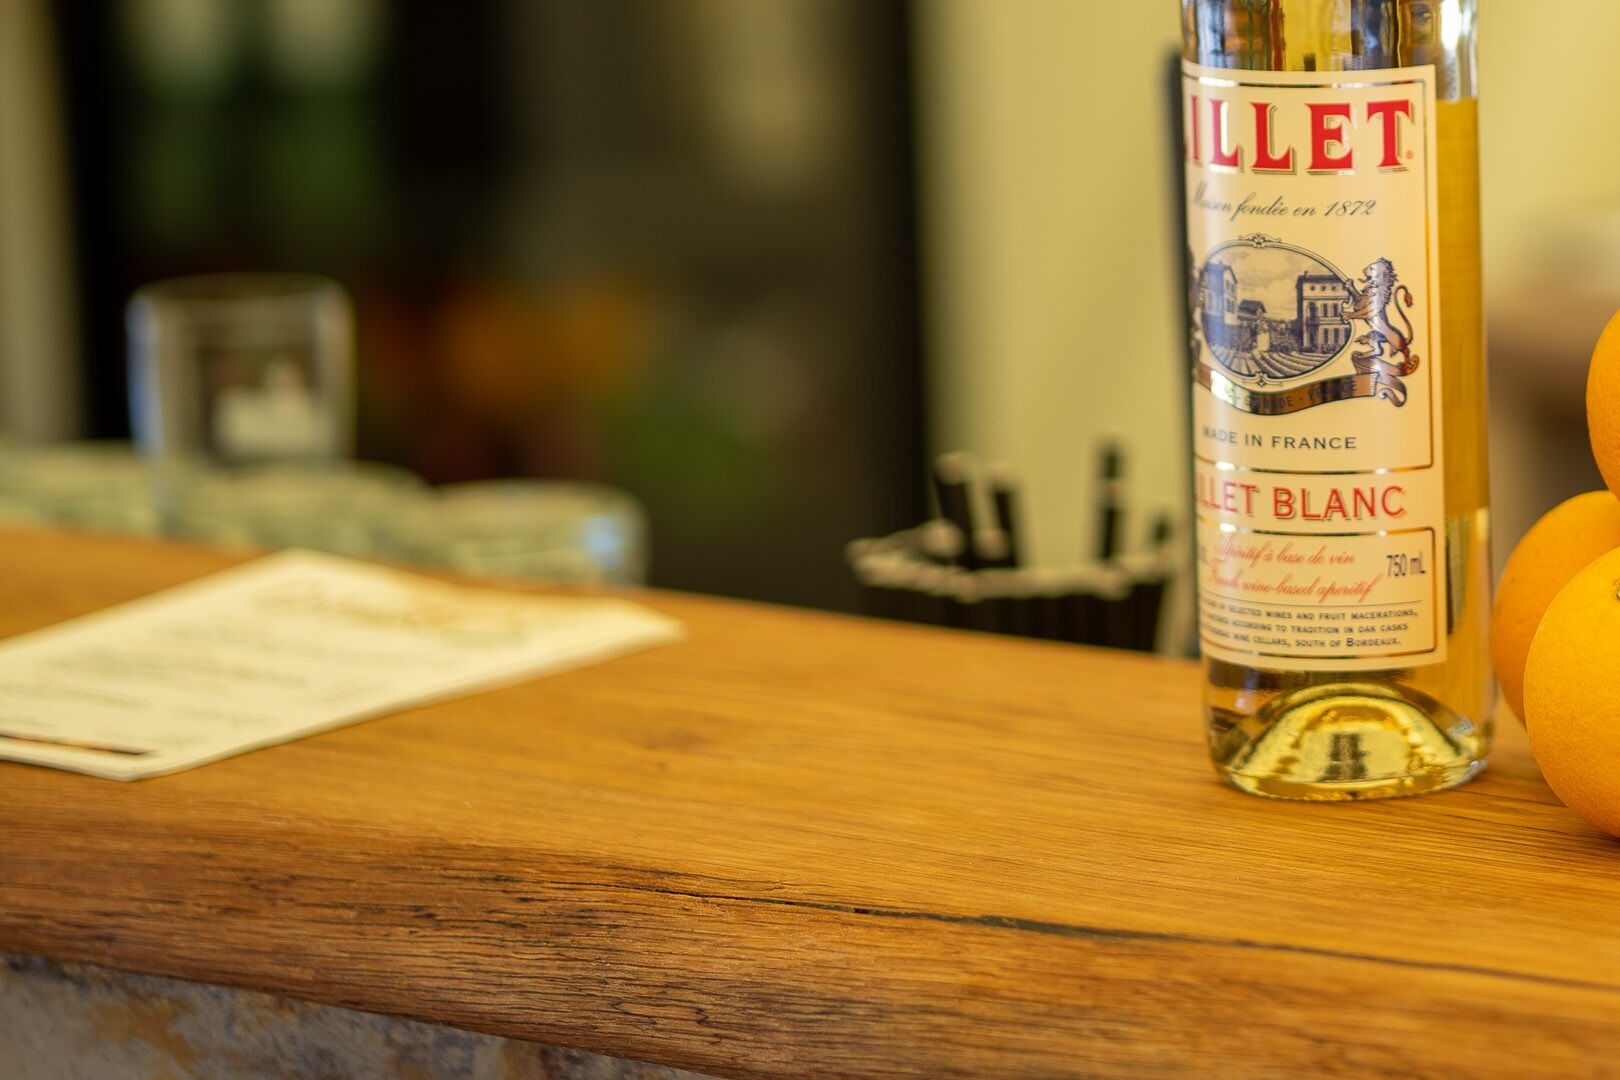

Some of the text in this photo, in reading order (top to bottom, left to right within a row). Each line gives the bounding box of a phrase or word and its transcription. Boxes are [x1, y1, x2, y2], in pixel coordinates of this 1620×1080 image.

[1184, 94, 1413, 172] ILLET
[1230, 191, 1288, 221] fondée
[1293, 205, 1316, 217] en
[1324, 199, 1376, 218] 1872
[1245, 433, 1263, 447] IN
[1272, 436, 1357, 450] FRANCE
[1272, 485, 1406, 521] BLANC
[1386, 552, 1407, 577] 750
